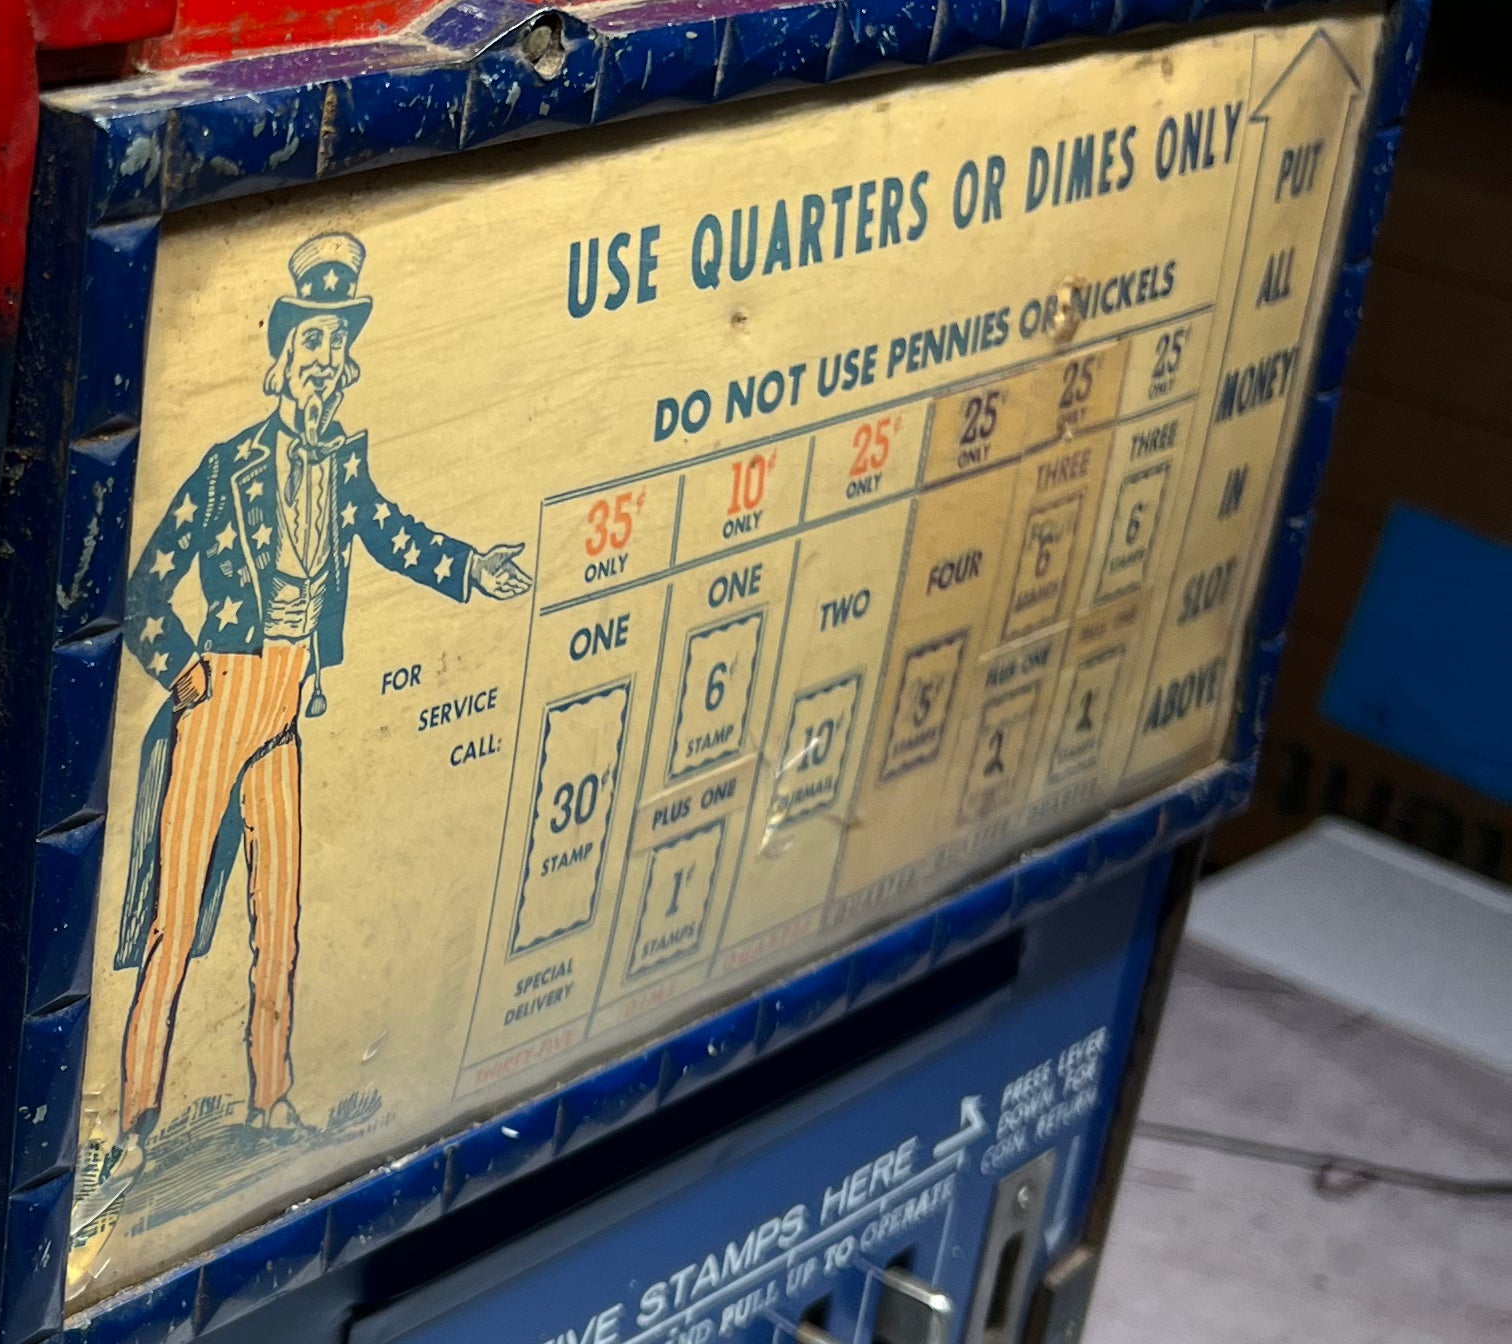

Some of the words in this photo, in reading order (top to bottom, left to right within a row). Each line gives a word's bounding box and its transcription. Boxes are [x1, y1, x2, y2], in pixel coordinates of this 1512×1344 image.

[1274, 139, 1323, 203] PUT
[567, 224, 661, 319] USE
[691, 169, 930, 291] QUARTERS
[953, 155, 1006, 230] OR
[1024, 124, 1137, 213] DIMES
[1155, 101, 1244, 183] ONLY
[1255, 247, 1296, 308] ALL
[653, 389, 712, 443] DO
[725, 363, 807, 424] NOT
[817, 345, 878, 398] USE
[887, 306, 1010, 380] PENNIES
[1019, 298, 1058, 340] OR
[1070, 259, 1177, 321] NICKELS
[957, 443, 993, 470] ONLY
[1130, 420, 1180, 462] THREE
[846, 473, 883, 500] ONLY
[1035, 449, 1093, 494] THREE
[1218, 462, 1248, 521] IN
[722, 510, 764, 540] ONLY
[584, 553, 629, 584] ONLY
[708, 561, 764, 609] ONE
[926, 549, 984, 596] FOUR
[820, 588, 871, 632] TWO
[569, 613, 631, 662] ONE
[380, 664, 422, 696] FOR
[1143, 657, 1224, 733] ABOVE
[417, 687, 499, 732] SERVICE
[450, 737, 503, 767] CALL:
[686, 723, 735, 757] STAMP
[651, 798, 690, 830] PLUS
[701, 778, 737, 809] ONE
[540, 842, 594, 877] STAMP
[514, 958, 574, 998] SPECIAL
[503, 982, 575, 1026] DELIVERY
[637, 1203, 810, 1328] STAMPS
[819, 1135, 921, 1226] HERE
[719, 1278, 780, 1339] PULL
[786, 1256, 818, 1297] UP
[823, 1236, 858, 1277] TO
[860, 1174, 956, 1256] OPERATE
